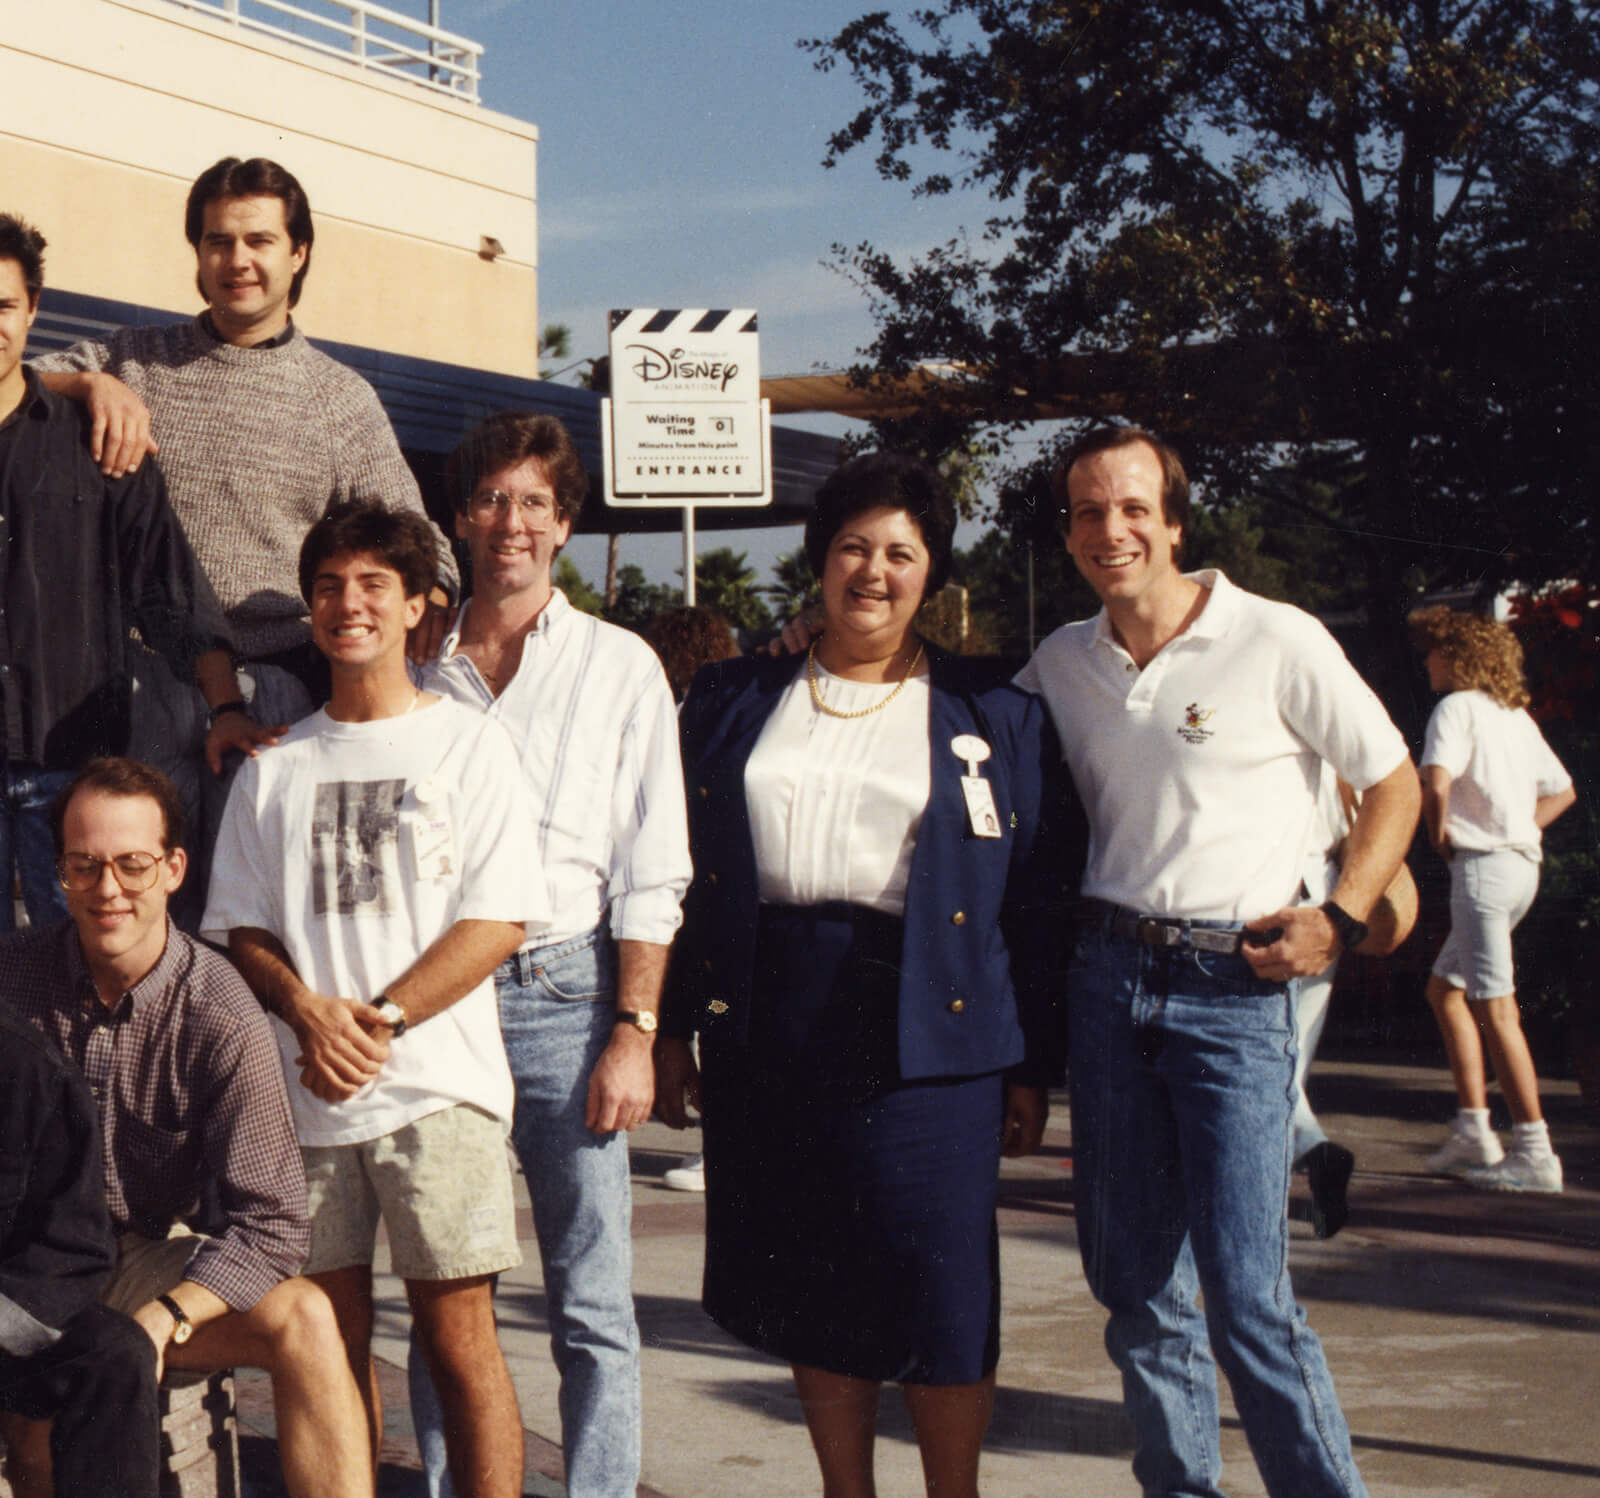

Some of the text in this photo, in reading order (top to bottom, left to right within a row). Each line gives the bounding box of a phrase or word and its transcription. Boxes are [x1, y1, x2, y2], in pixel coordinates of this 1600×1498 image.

[624, 344, 738, 392] Disney
[646, 415, 725, 432] Waiting 0
[666, 426, 695, 435] Time
[715, 442, 738, 450] point
[635, 465, 742, 475] ENTRANCE
